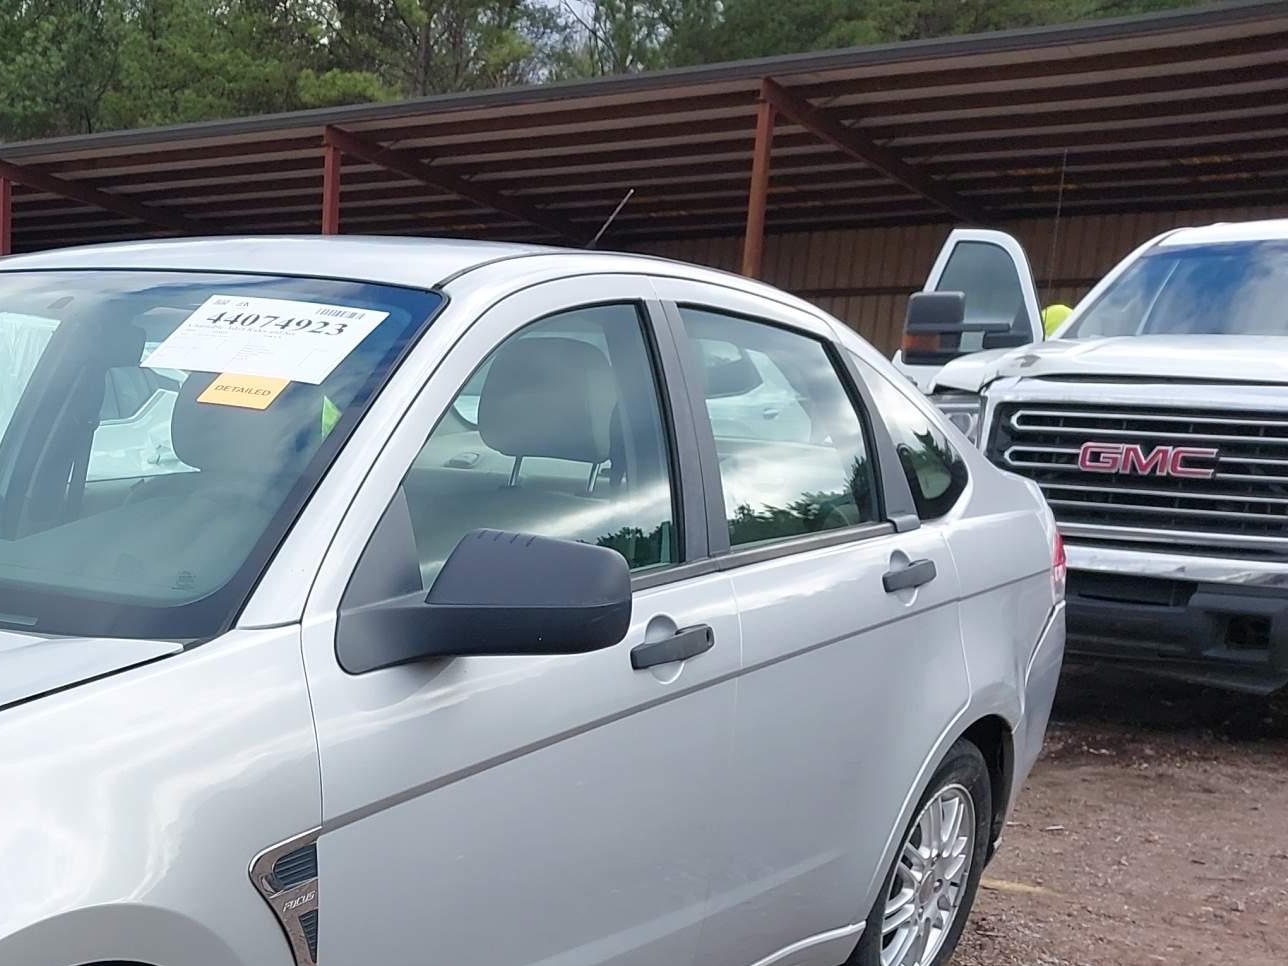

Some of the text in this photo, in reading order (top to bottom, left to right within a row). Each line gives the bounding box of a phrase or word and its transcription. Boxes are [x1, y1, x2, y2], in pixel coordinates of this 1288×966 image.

[205, 311, 349, 337] 44074923
[214, 384, 272, 397] DETAILED
[1078, 441, 1220, 479] GMC
